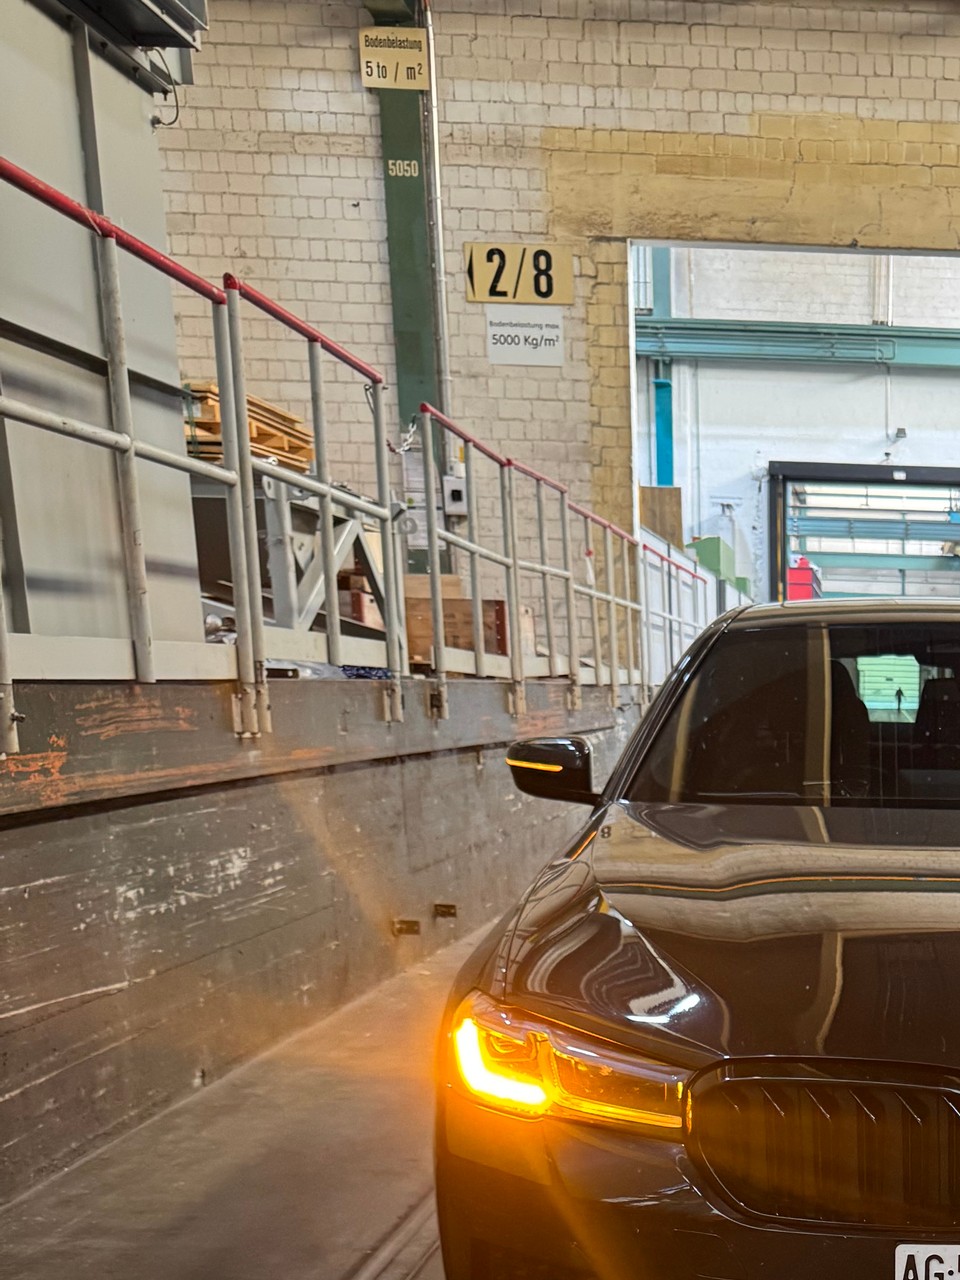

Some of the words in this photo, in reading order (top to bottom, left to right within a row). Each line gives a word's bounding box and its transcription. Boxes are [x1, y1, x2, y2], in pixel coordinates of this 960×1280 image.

[364, 34, 422, 52] Bodenbelastung
[365, 60, 373, 77] 5
[376, 62, 388, 79] to
[388, 159, 419, 177] 5050
[486, 247, 553, 298] 2/8
[489, 320, 543, 330] Bodenbelastung
[492, 333, 520, 345] 5000
